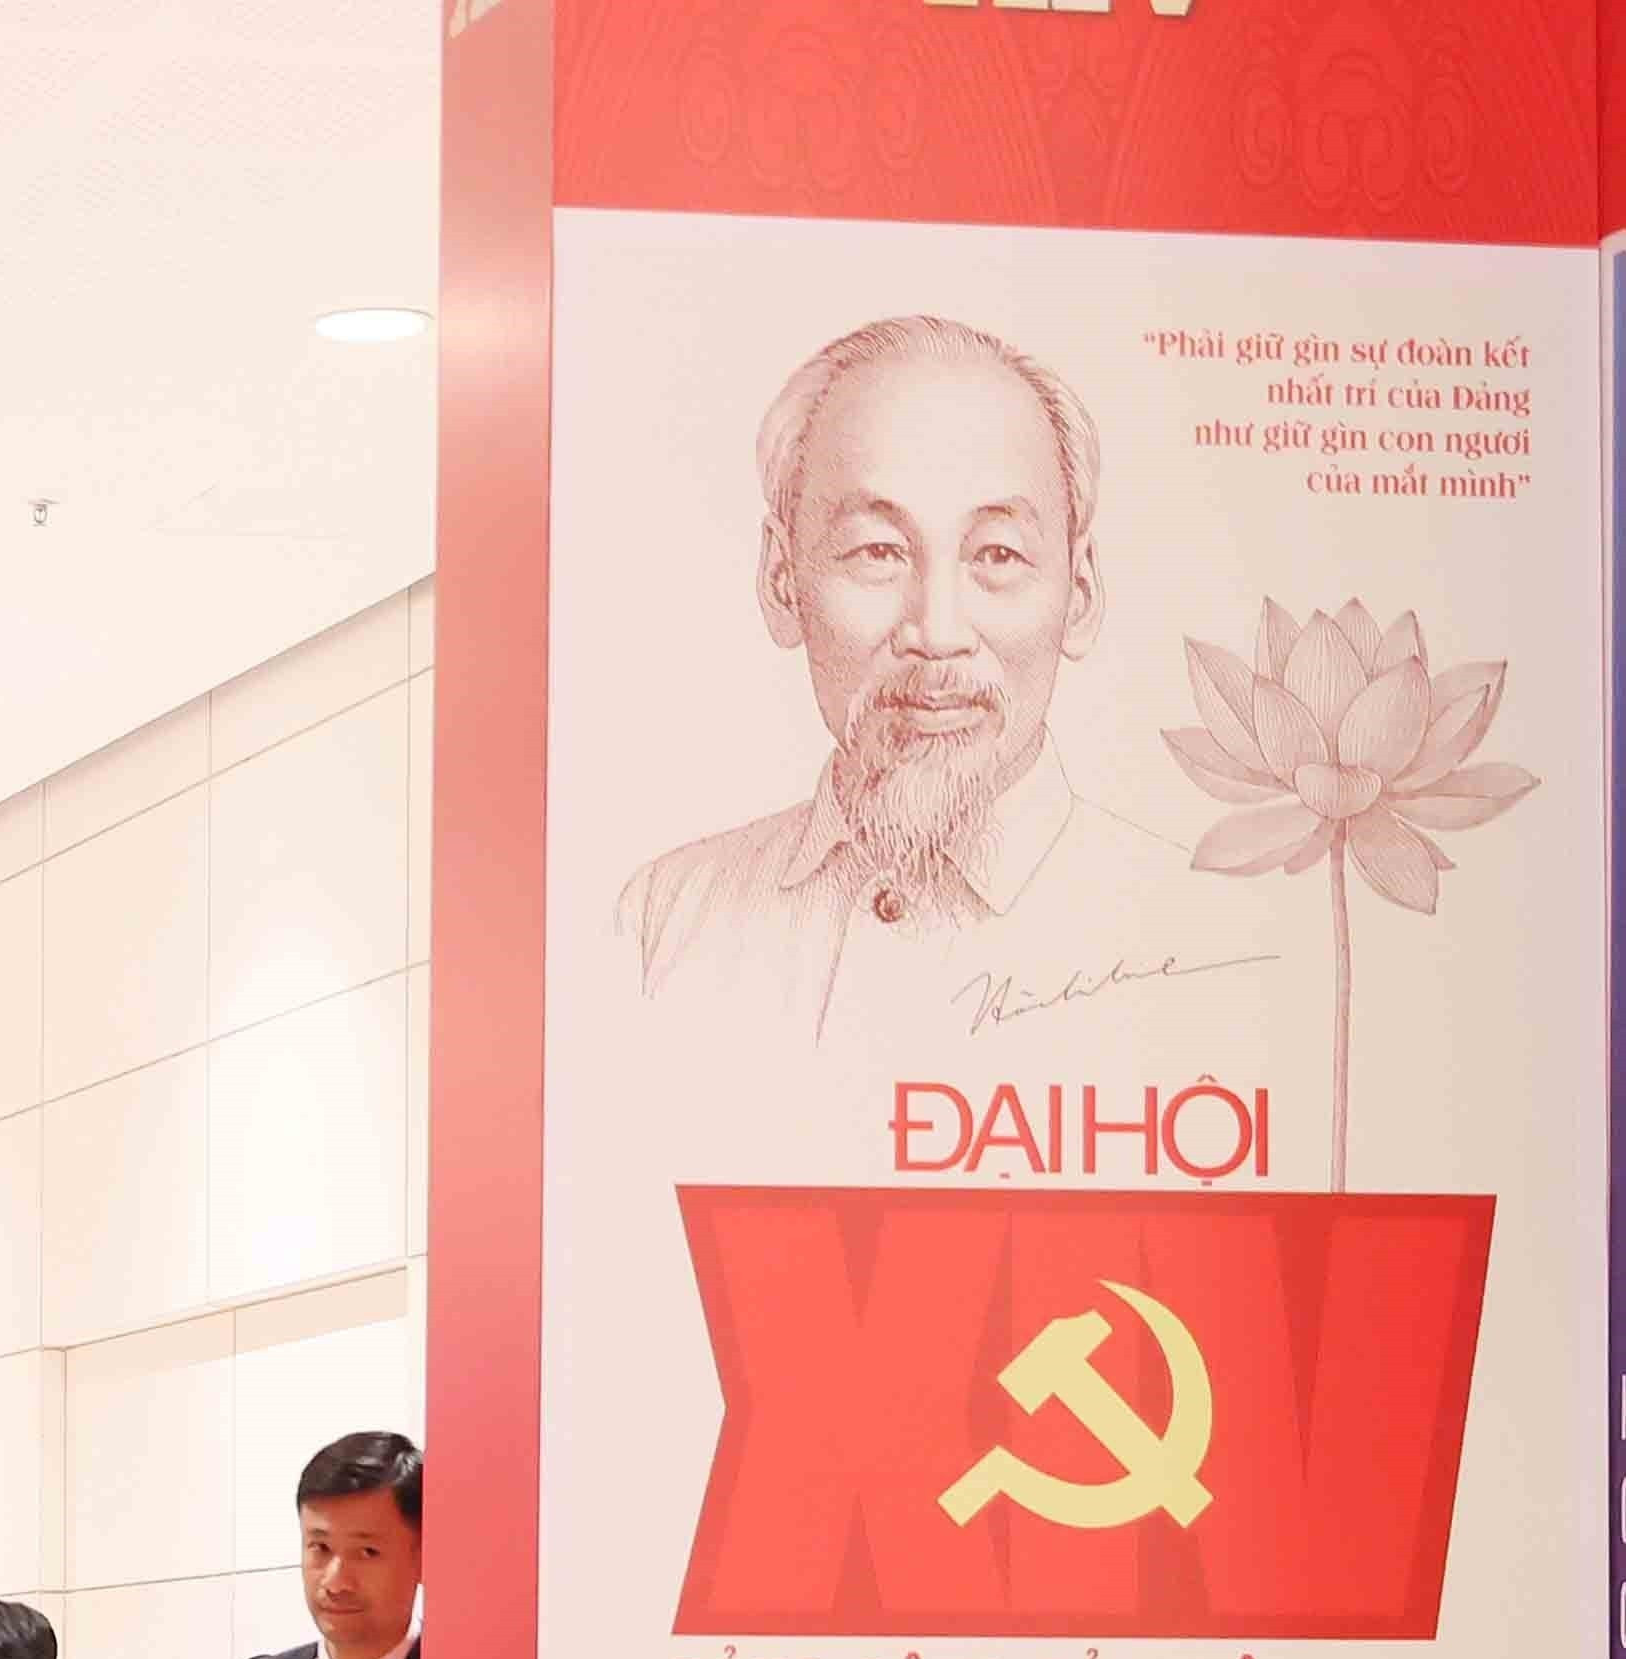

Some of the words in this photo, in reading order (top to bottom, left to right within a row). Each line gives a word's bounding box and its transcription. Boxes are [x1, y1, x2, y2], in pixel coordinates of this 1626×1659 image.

[1235, 331, 1286, 365] giữ
[1292, 333, 1341, 367] gìn
[1349, 339, 1389, 371] sự
[1396, 337, 1473, 368] đoàn
[1483, 335, 1531, 369] kết
[1266, 372, 1334, 408] nhất
[1343, 377, 1377, 408] trí
[1386, 378, 1442, 410] của
[1450, 380, 1532, 418] Đảng
[1194, 418, 1255, 448] như
[1262, 421, 1313, 454] giữ
[1320, 422, 1368, 456] gìn
[1378, 430, 1436, 454] con
[1305, 464, 1362, 495] của
[1371, 463, 1430, 496] mắt
[887, 1080, 1062, 1180] ĐẠI
[1082, 1072, 1269, 1187] HỘI
